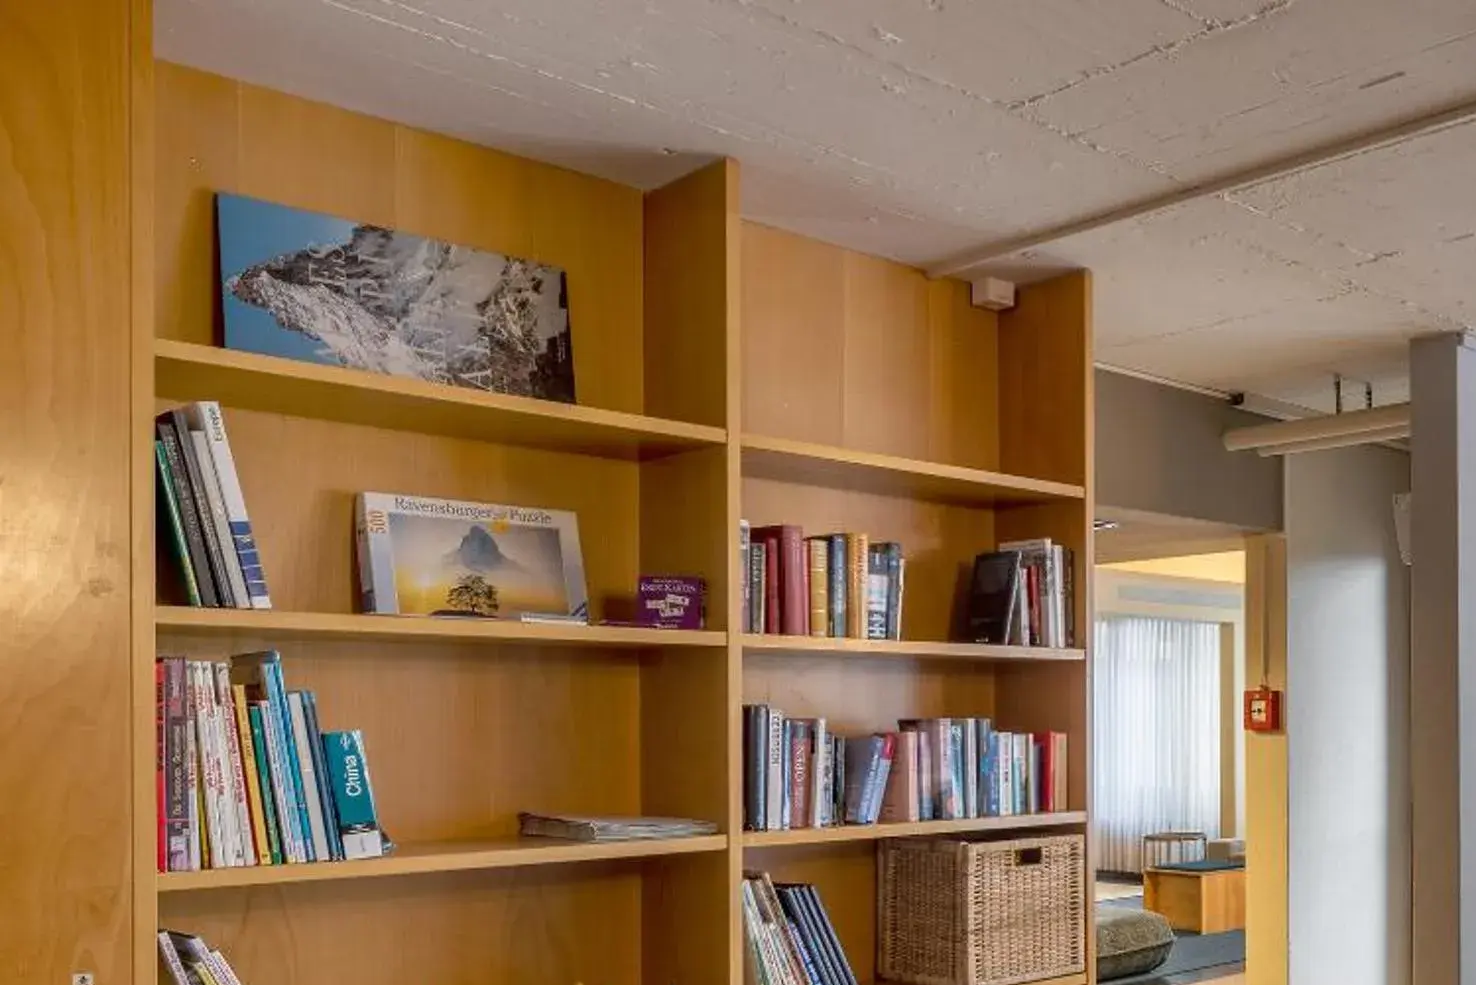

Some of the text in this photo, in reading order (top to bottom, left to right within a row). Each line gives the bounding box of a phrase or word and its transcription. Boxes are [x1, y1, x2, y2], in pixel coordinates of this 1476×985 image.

[367, 510, 388, 535] 500
[394, 497, 492, 520] Ravensburger
[509, 508, 552, 525] Puzzle
[346, 754, 363, 798] China
